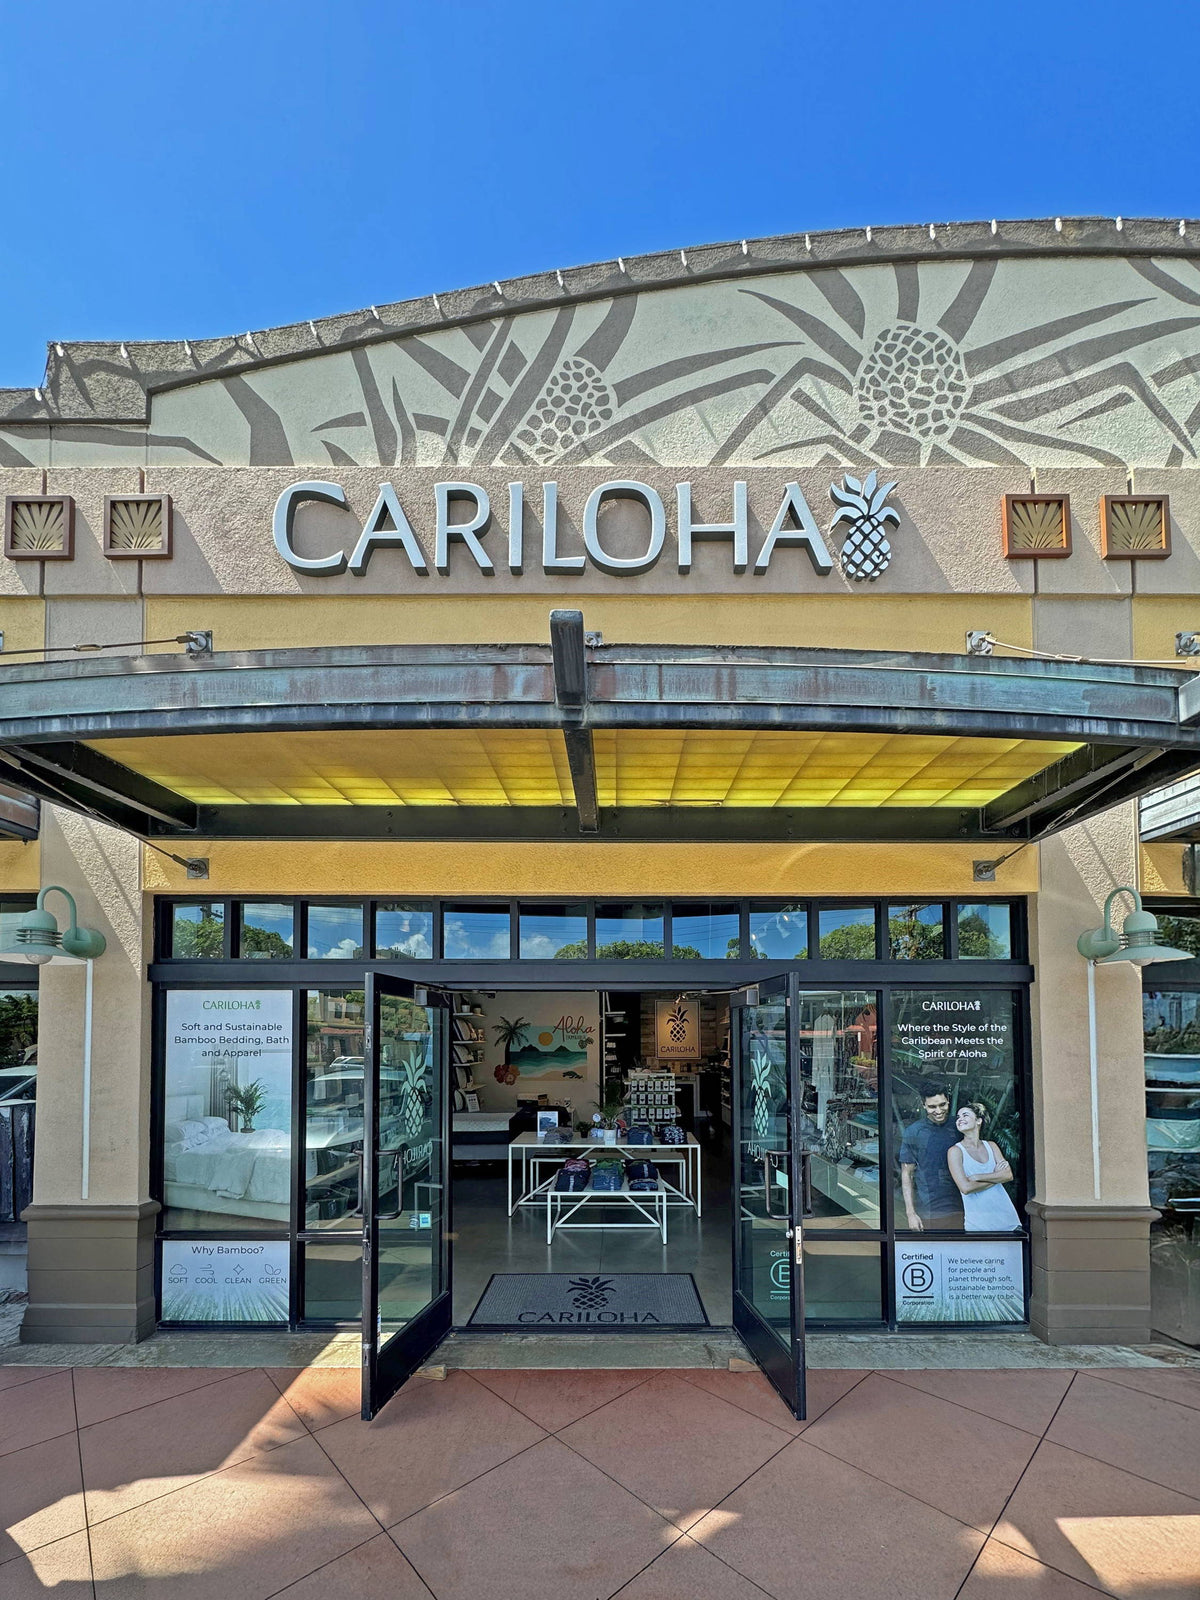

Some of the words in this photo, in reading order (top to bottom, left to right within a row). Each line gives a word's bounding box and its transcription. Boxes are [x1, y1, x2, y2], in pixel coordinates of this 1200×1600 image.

[272, 480, 833, 576] CARILOHA
[203, 1000, 254, 1010] CARILOHA
[922, 1001, 975, 1011] CARILOHA
[181, 1023, 201, 1031] Soft
[203, 1023, 223, 1031] and
[225, 1023, 283, 1031] Sustainable
[552, 1016, 596, 1042] Aloha
[898, 1024, 931, 1032] Where
[933, 1024, 949, 1032] the
[951, 1024, 976, 1034] Style
[978, 1024, 989, 1032] of
[991, 1024, 1007, 1032] the
[174, 1036, 216, 1044] Bamboo
[219, 1036, 264, 1046] Bedding,
[266, 1036, 290, 1044] Bath
[901, 1037, 952, 1045] Caribbean
[954, 1037, 985, 1045] Meets
[986, 1037, 1004, 1045] the
[201, 1049, 221, 1057] and
[222, 1049, 262, 1058] Apparel
[918, 1050, 944, 1060] Spirit
[946, 1050, 958, 1058] of
[958, 1050, 987, 1058] Aloha
[191, 1246, 215, 1256] Why
[217, 1246, 265, 1254] Bamboo?
[959, 1267, 981, 1275] people
[911, 1268, 926, 1287] B
[518, 1311, 660, 1323] CARILOHA
